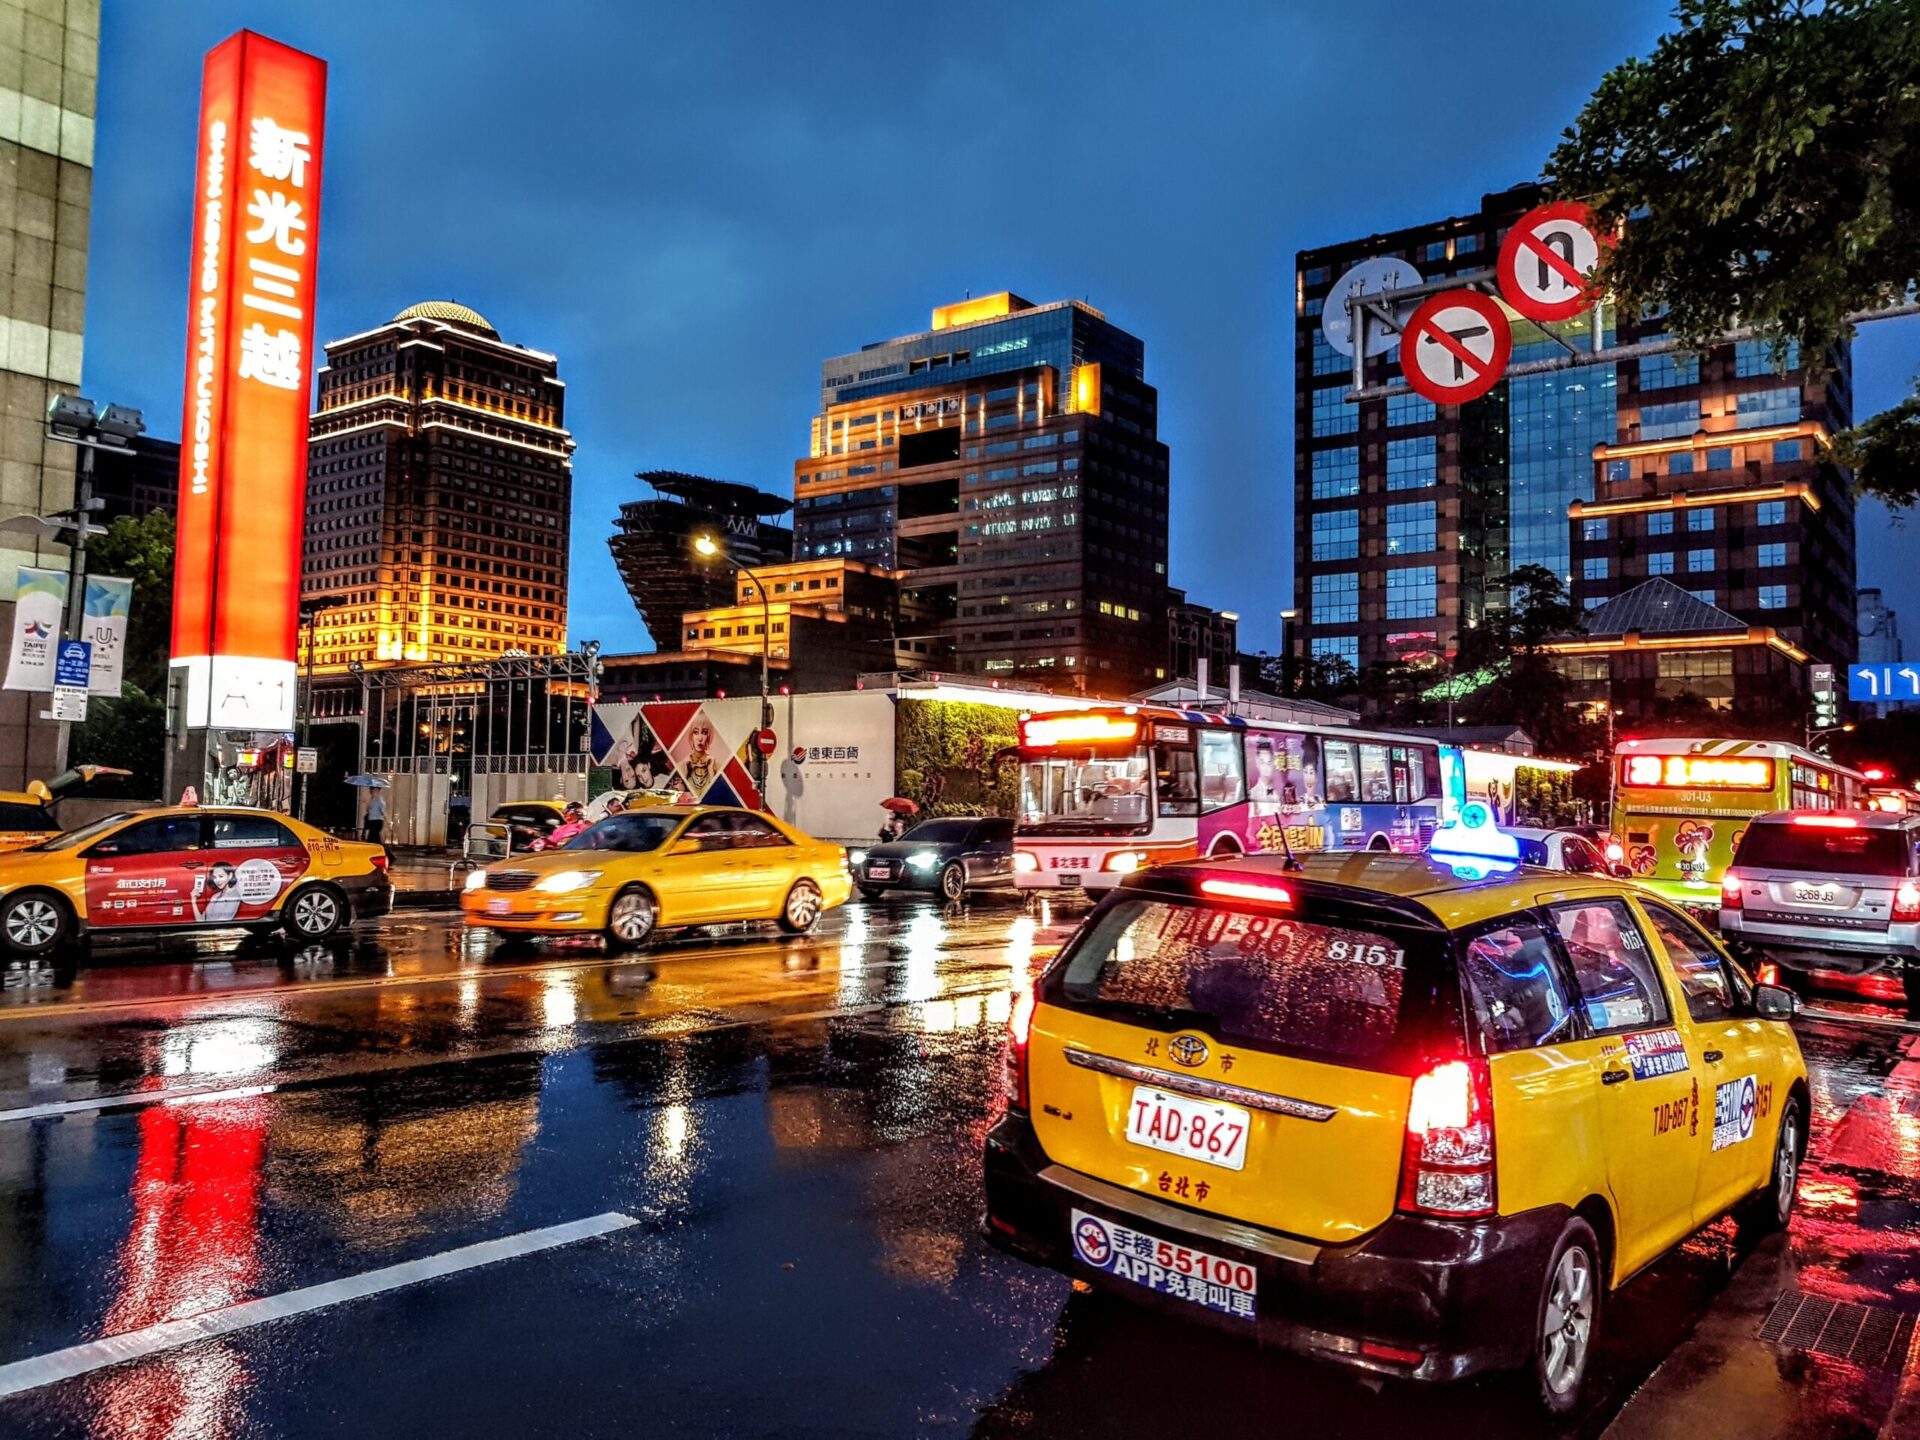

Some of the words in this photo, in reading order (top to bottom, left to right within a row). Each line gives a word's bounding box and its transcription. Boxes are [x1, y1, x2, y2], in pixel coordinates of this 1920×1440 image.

[238, 116, 311, 391] 新光三越
[23, 641, 47, 649] TAIPEI
[808, 746, 859, 760] 遠東百貨
[1681, 791, 1711, 802] 301-U3
[1620, 929, 1644, 950] 8151
[1327, 940, 1407, 970] 8151
[1145, 1037, 1160, 1057] 北
[1220, 1053, 1236, 1073] 市
[1653, 1097, 1689, 1136] TAD-867
[1158, 1171, 1211, 1202] 台北市
